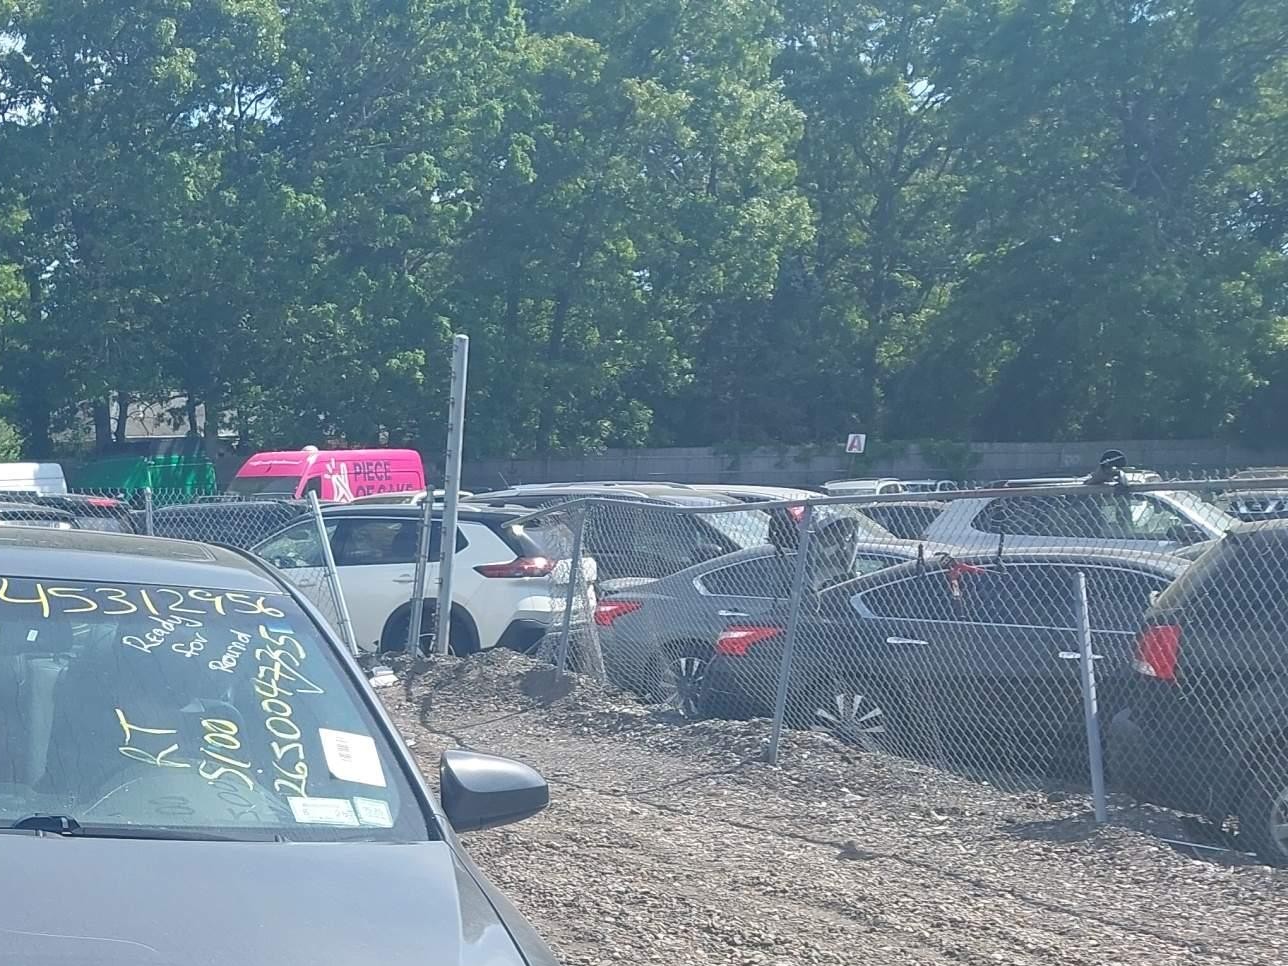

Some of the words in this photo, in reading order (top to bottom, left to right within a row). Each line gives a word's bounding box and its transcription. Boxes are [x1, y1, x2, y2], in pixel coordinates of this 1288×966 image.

[848, 434, 862, 451] A
[354, 461, 391, 481] PIECE
[122, 614, 203, 653] Ready
[172, 631, 208, 657] for
[115, 708, 191, 767] RT
